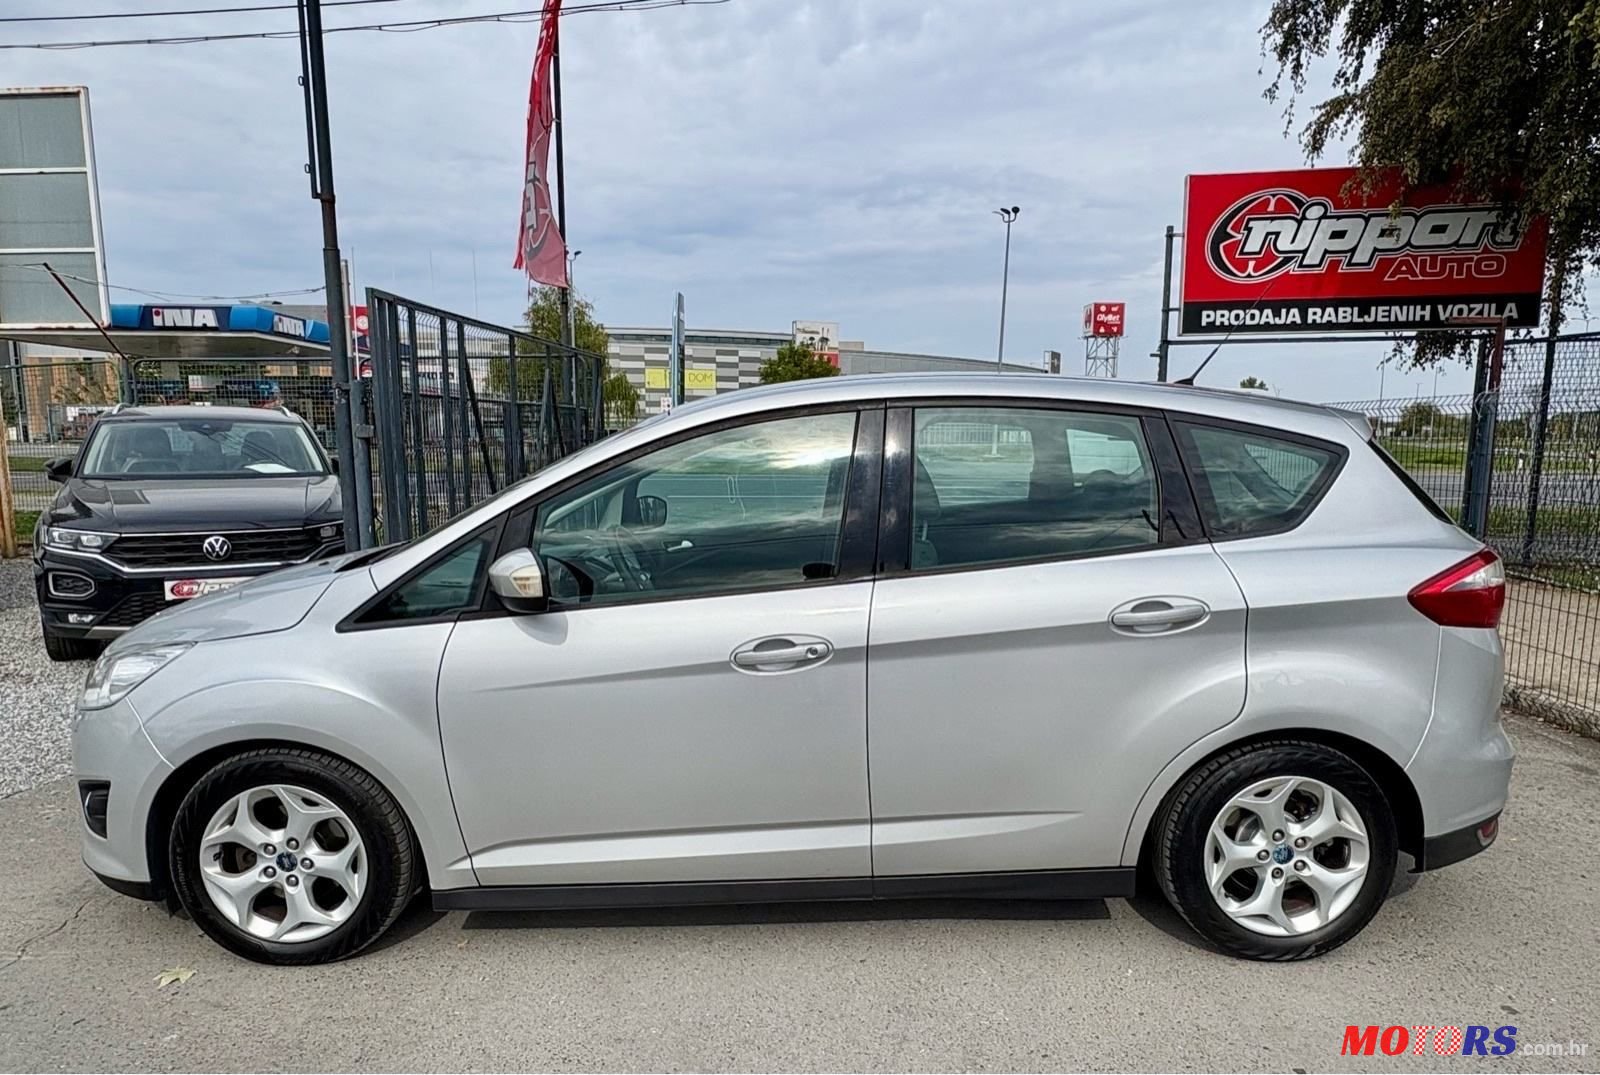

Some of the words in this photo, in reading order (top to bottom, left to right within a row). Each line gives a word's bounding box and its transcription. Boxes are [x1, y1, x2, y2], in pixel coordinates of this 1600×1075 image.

[1383, 253, 1507, 280] AUTO
[1201, 308, 1302, 327] PRODAJA
[1306, 305, 1431, 324] RABLJENIH
[1437, 303, 1519, 321] VOZILA
[688, 372, 713, 383] DOM
